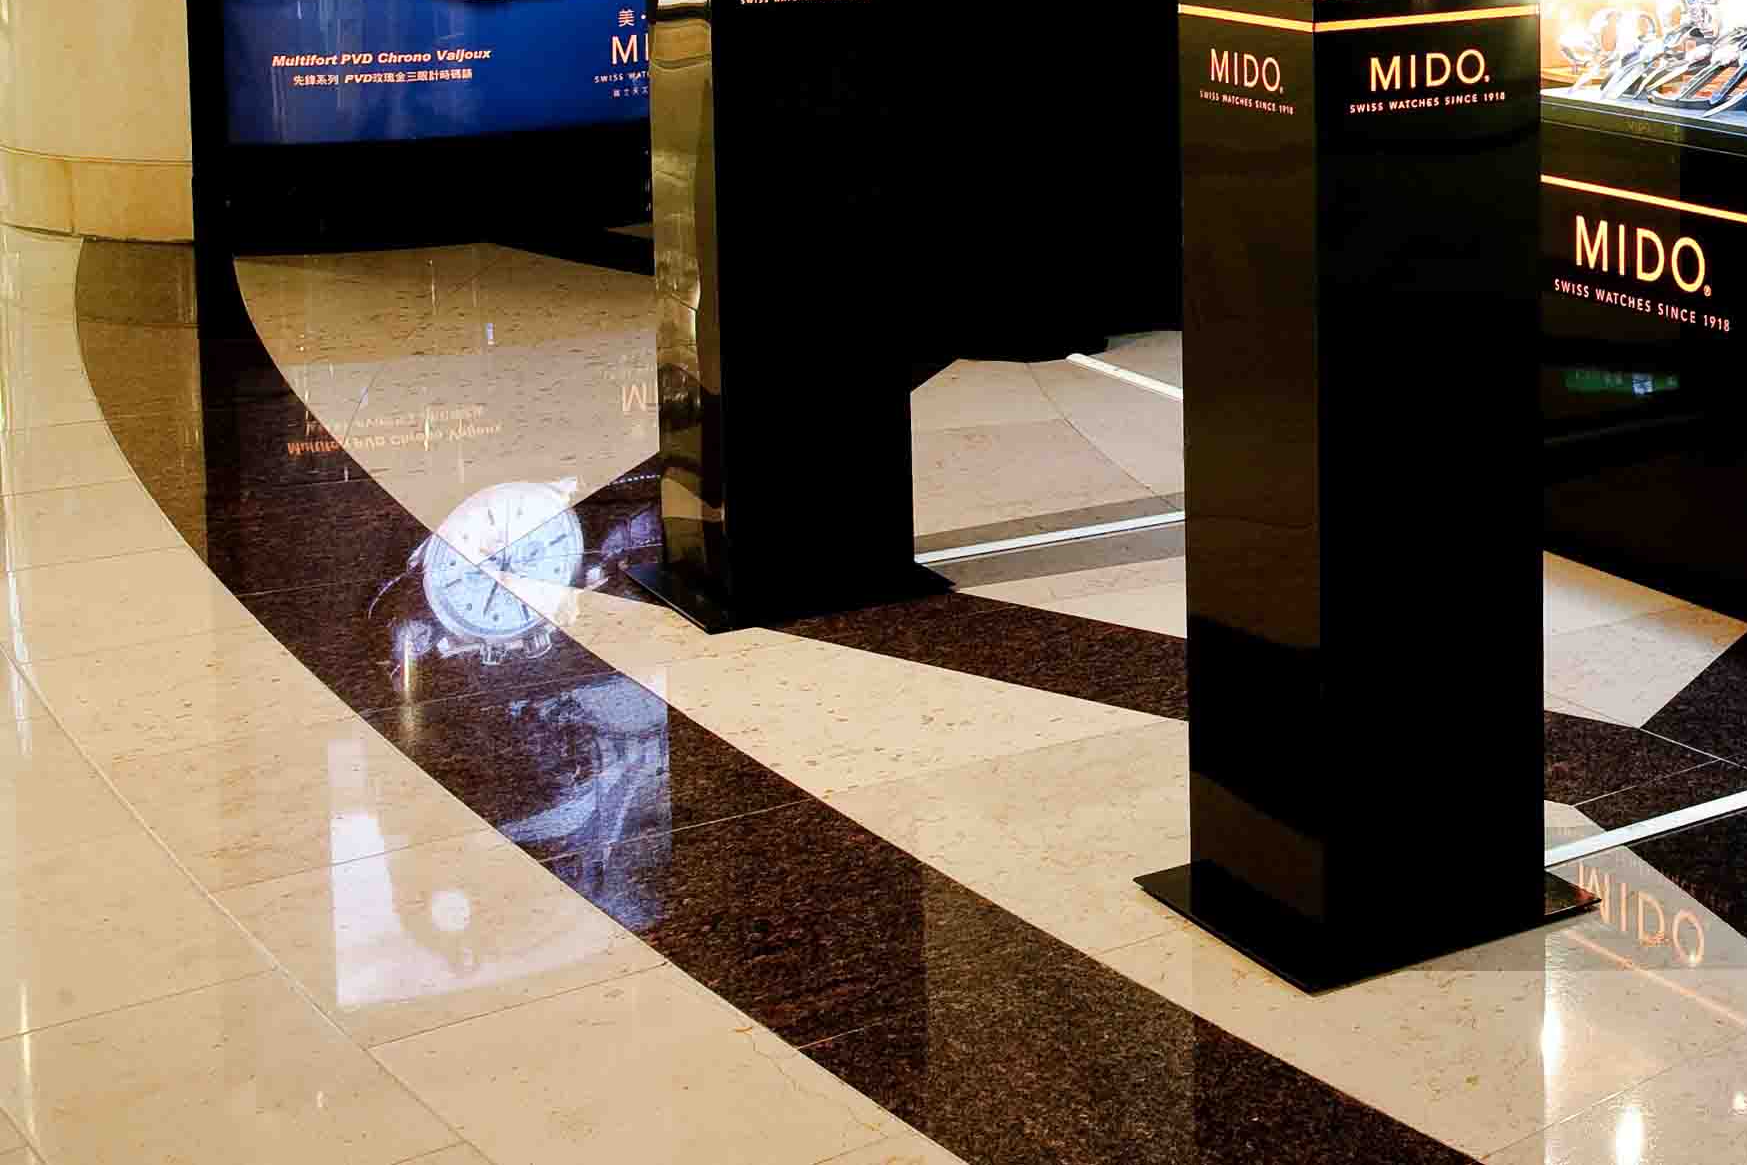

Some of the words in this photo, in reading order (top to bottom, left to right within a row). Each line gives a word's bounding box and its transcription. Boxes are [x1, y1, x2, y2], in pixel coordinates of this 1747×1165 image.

[272, 54, 338, 67] Multifort
[341, 53, 373, 65] PVD
[378, 51, 432, 64] Chrono
[436, 49, 491, 62] Valjoux
[1210, 48, 1281, 92] MIDO
[1370, 49, 1486, 92] MIDO
[1199, 90, 1220, 102] SWISS
[1222, 93, 1253, 109] WATCHES
[1255, 99, 1277, 113] SINCE
[1350, 102, 1384, 114] SWISS
[1388, 97, 1440, 110] WATCHES
[1445, 93, 1478, 105] SINCE
[1484, 91, 1506, 102] 1918
[1576, 215, 1706, 292] MIDO
[1554, 278, 1590, 299] SWISS
[1595, 288, 1651, 313] WATCHES
[1657, 302, 1697, 324] SINCE
[1703, 314, 1730, 332] 1918
